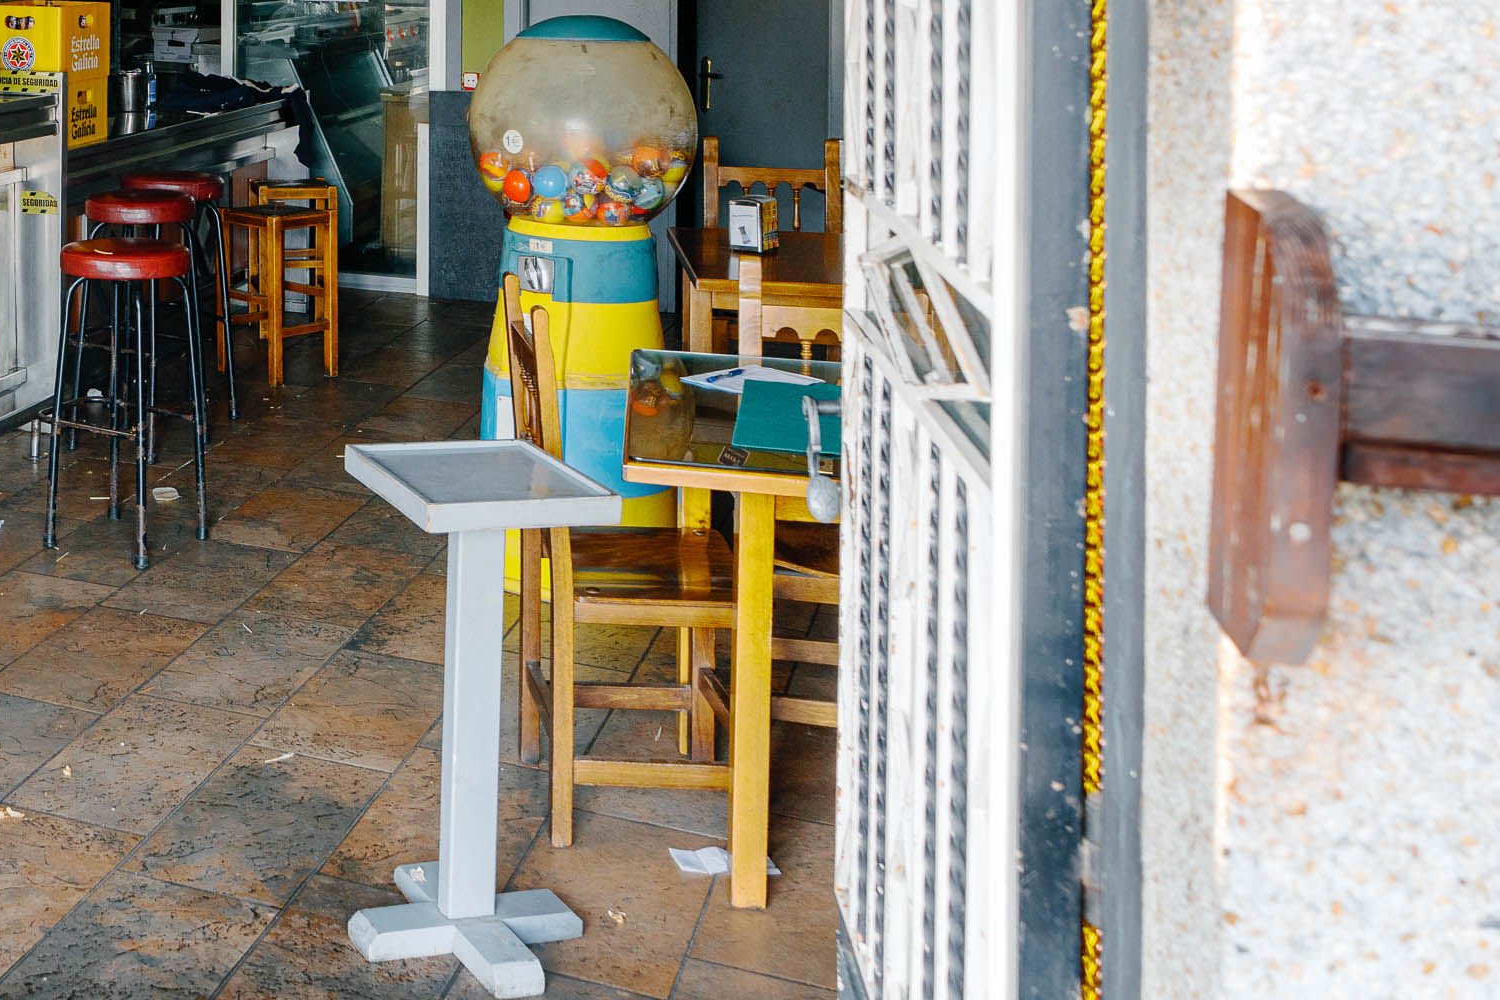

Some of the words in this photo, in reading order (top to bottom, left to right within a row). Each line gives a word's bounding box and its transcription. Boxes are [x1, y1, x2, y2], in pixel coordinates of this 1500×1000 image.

[70, 34, 100, 53] Estrella
[71, 51, 99, 72] Galicia
[13, 77, 22, 85] DE
[22, 78, 58, 88] SEGURIDAD
[70, 104, 97, 123] Estrella
[71, 120, 96, 140] Galicia
